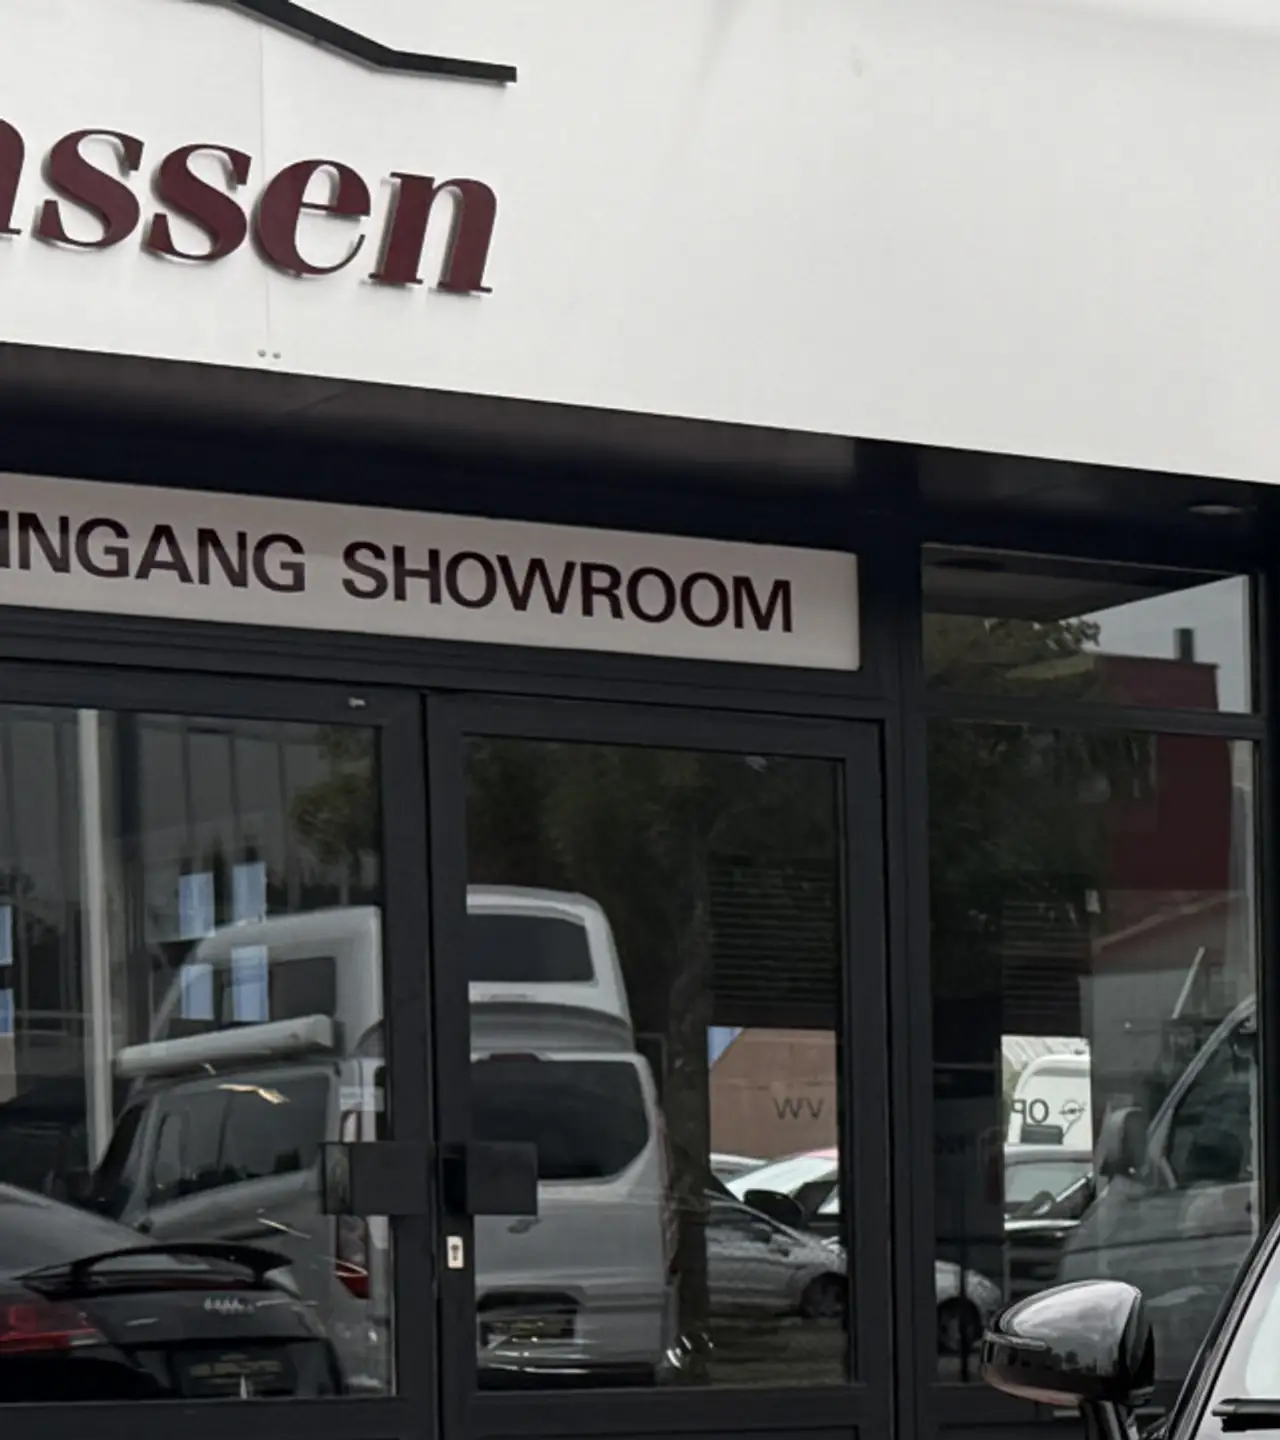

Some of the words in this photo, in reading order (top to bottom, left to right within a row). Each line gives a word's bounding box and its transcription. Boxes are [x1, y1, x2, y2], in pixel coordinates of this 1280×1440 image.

[0, 118, 498, 293] ssen
[0, 509, 306, 594] INGANG
[342, 540, 794, 633] SHOWROOM
